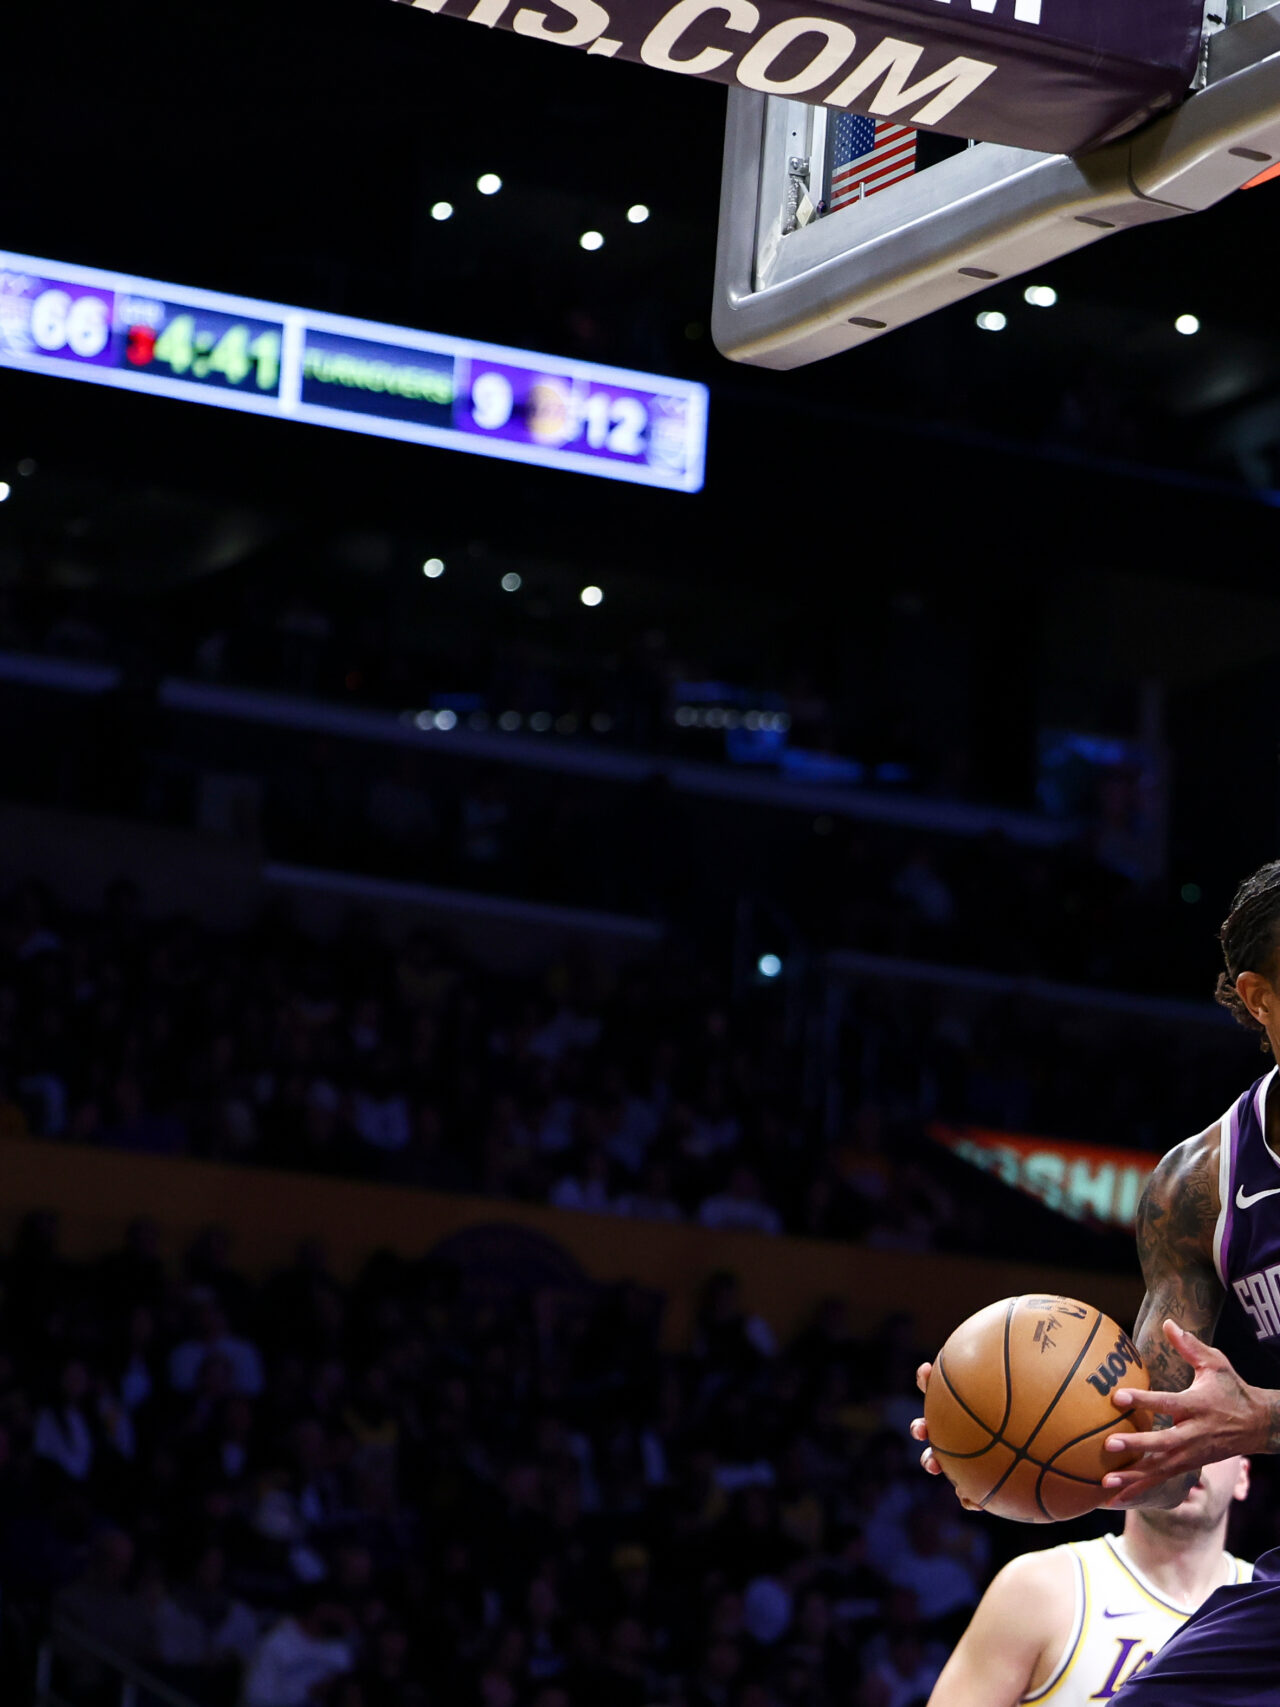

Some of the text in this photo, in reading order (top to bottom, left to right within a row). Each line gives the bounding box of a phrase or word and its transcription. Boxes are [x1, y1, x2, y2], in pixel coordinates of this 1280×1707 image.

[390, 0, 997, 126] S.COM
[31, 289, 109, 357] 66
[154, 313, 281, 390] 4:41
[472, 372, 513, 430] 9
[587, 391, 648, 456] 12
